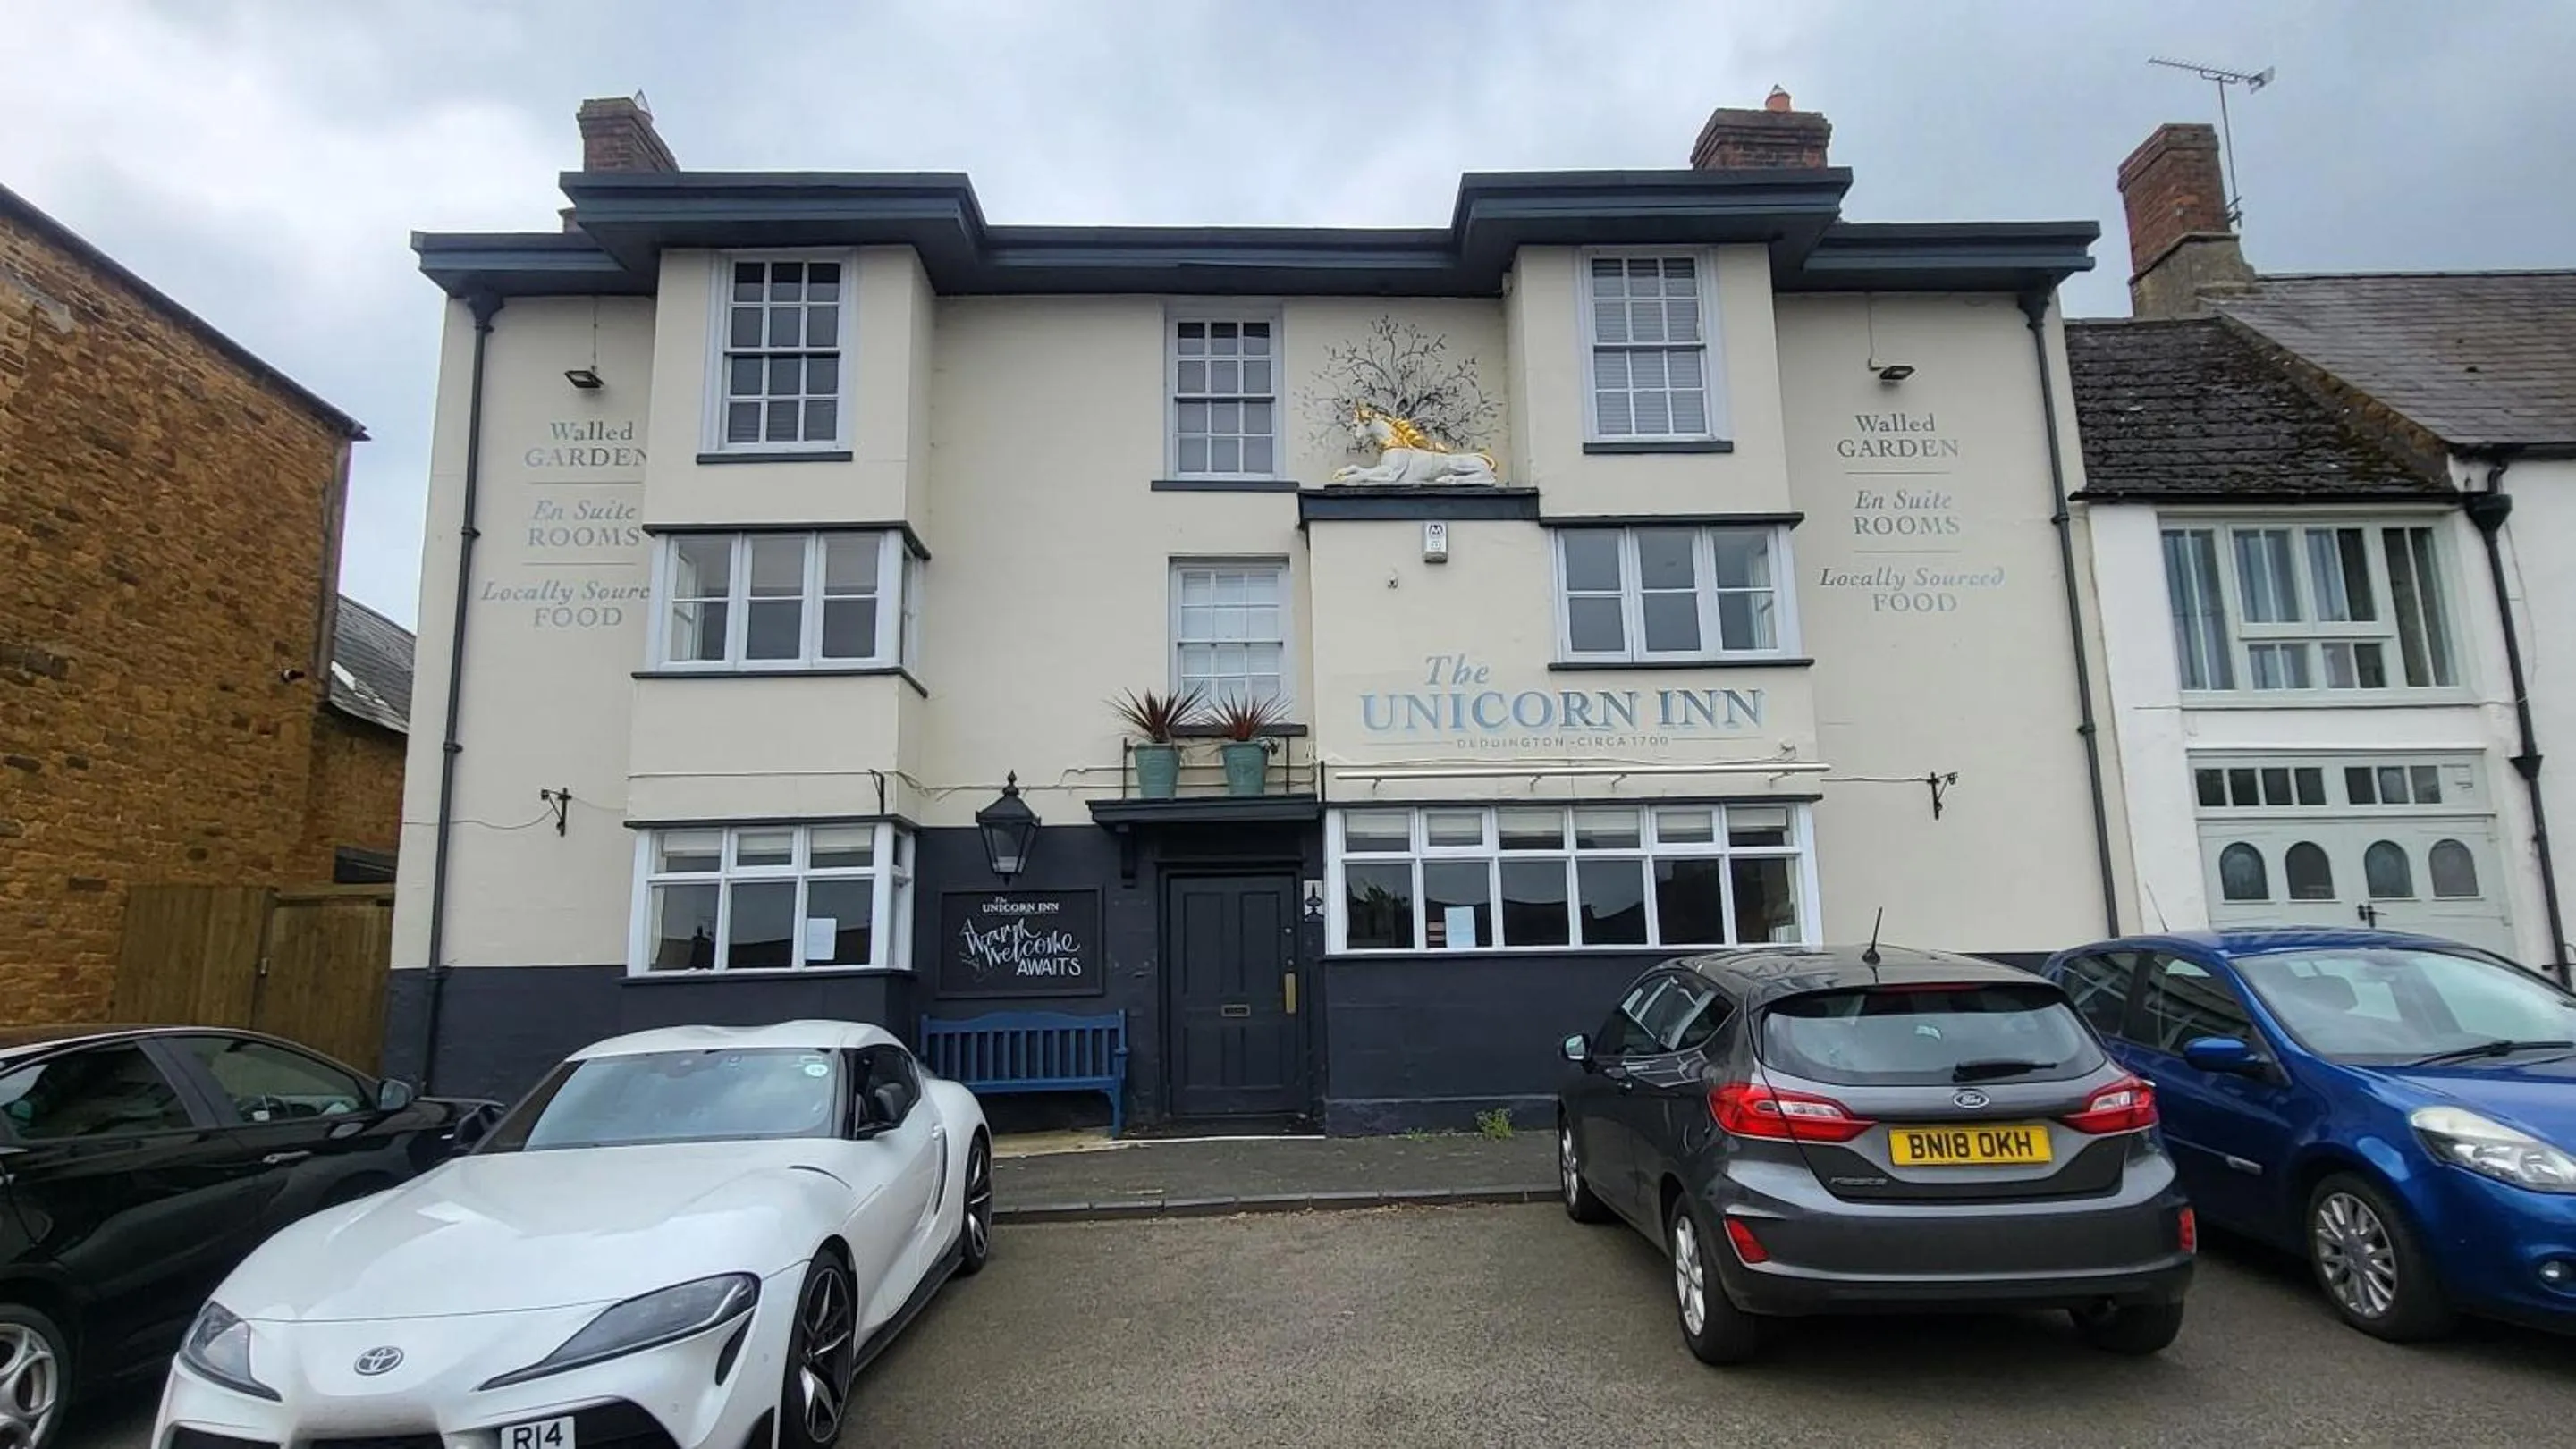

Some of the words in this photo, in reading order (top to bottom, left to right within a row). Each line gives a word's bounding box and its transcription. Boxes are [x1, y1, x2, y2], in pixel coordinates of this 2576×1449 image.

[550, 421, 633, 441] Walled
[1854, 413, 1936, 433] Walled
[1837, 439, 1959, 458] GARDEN
[1854, 490, 1884, 510] En
[1893, 489, 1952, 510] Suite
[532, 501, 564, 520] En
[573, 500, 637, 520] Suite
[1854, 516, 1961, 535] ROOMS
[528, 527, 641, 547] ROOMS
[1819, 565, 1905, 591] Locally
[1913, 566, 2005, 587] Sourced
[481, 580, 573, 605] Locally
[581, 580, 651, 601] Sourc
[1873, 593, 1957, 612] FOOD
[534, 608, 622, 628] FOOD
[1424, 654, 1491, 687] The
[1359, 689, 1640, 731] UNICORN
[1656, 687, 1765, 728] INN
[1632, 735, 1669, 746] 1700
[982, 903, 1035, 913] UNICORN
[1038, 902, 1060, 911] INN
[984, 930, 1081, 968] Welcome
[1016, 957, 1082, 976] AWAITS
[1907, 1133, 1971, 1160] BN18
[1978, 1131, 2034, 1157] OKH
[513, 1421, 563, 1449] R14
